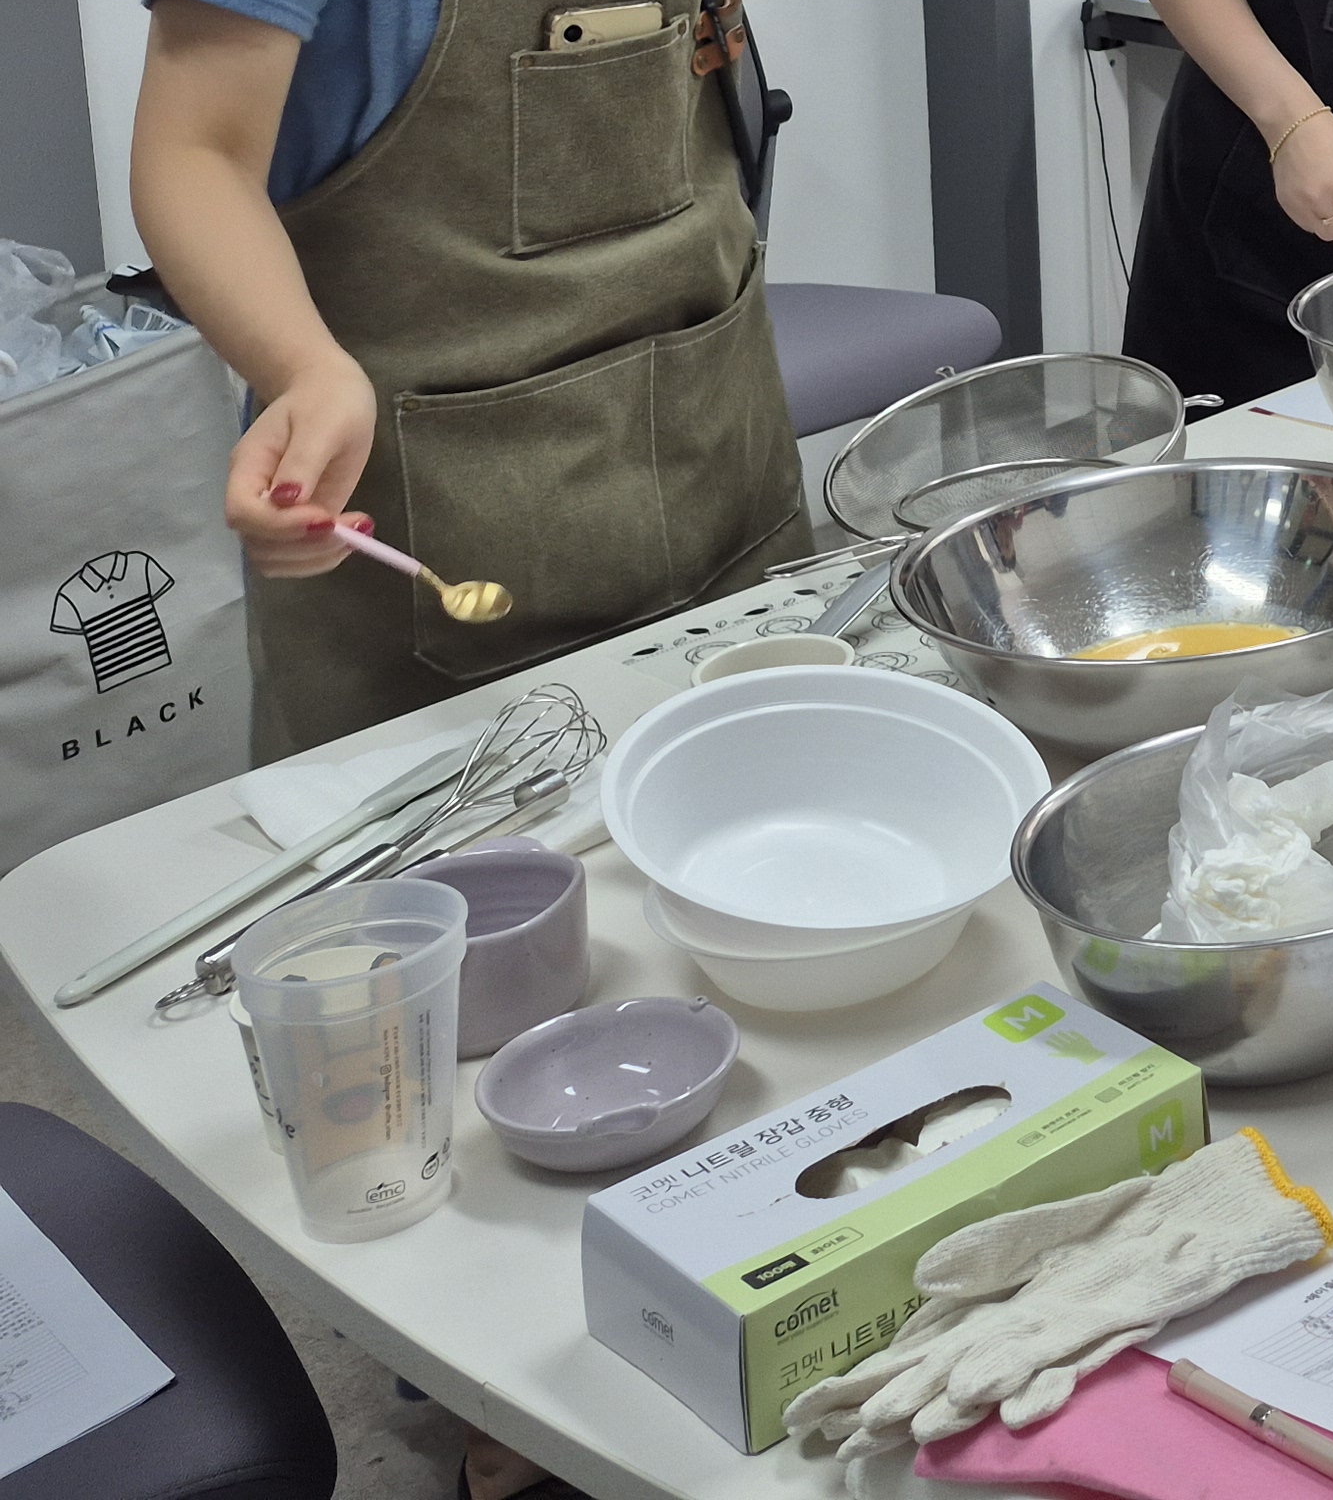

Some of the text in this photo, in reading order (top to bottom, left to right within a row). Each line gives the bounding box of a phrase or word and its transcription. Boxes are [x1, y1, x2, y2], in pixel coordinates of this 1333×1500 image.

[61, 687, 205, 762] BLACK
[1004, 1002, 1046, 1032] M
[630, 1093, 855, 1203] 코멧 니트릴 장갑 중형
[1150, 1115, 1173, 1152] M
[646, 1107, 869, 1215] COMET NITRILE GLOVES
[369, 1184, 402, 1201] emc
[756, 1259, 798, 1282] 100매
[642, 1308, 674, 1342] comet
[774, 1288, 840, 1339] comet
[779, 1349, 825, 1391] 코멧
[831, 1307, 899, 1359] 니트릴
